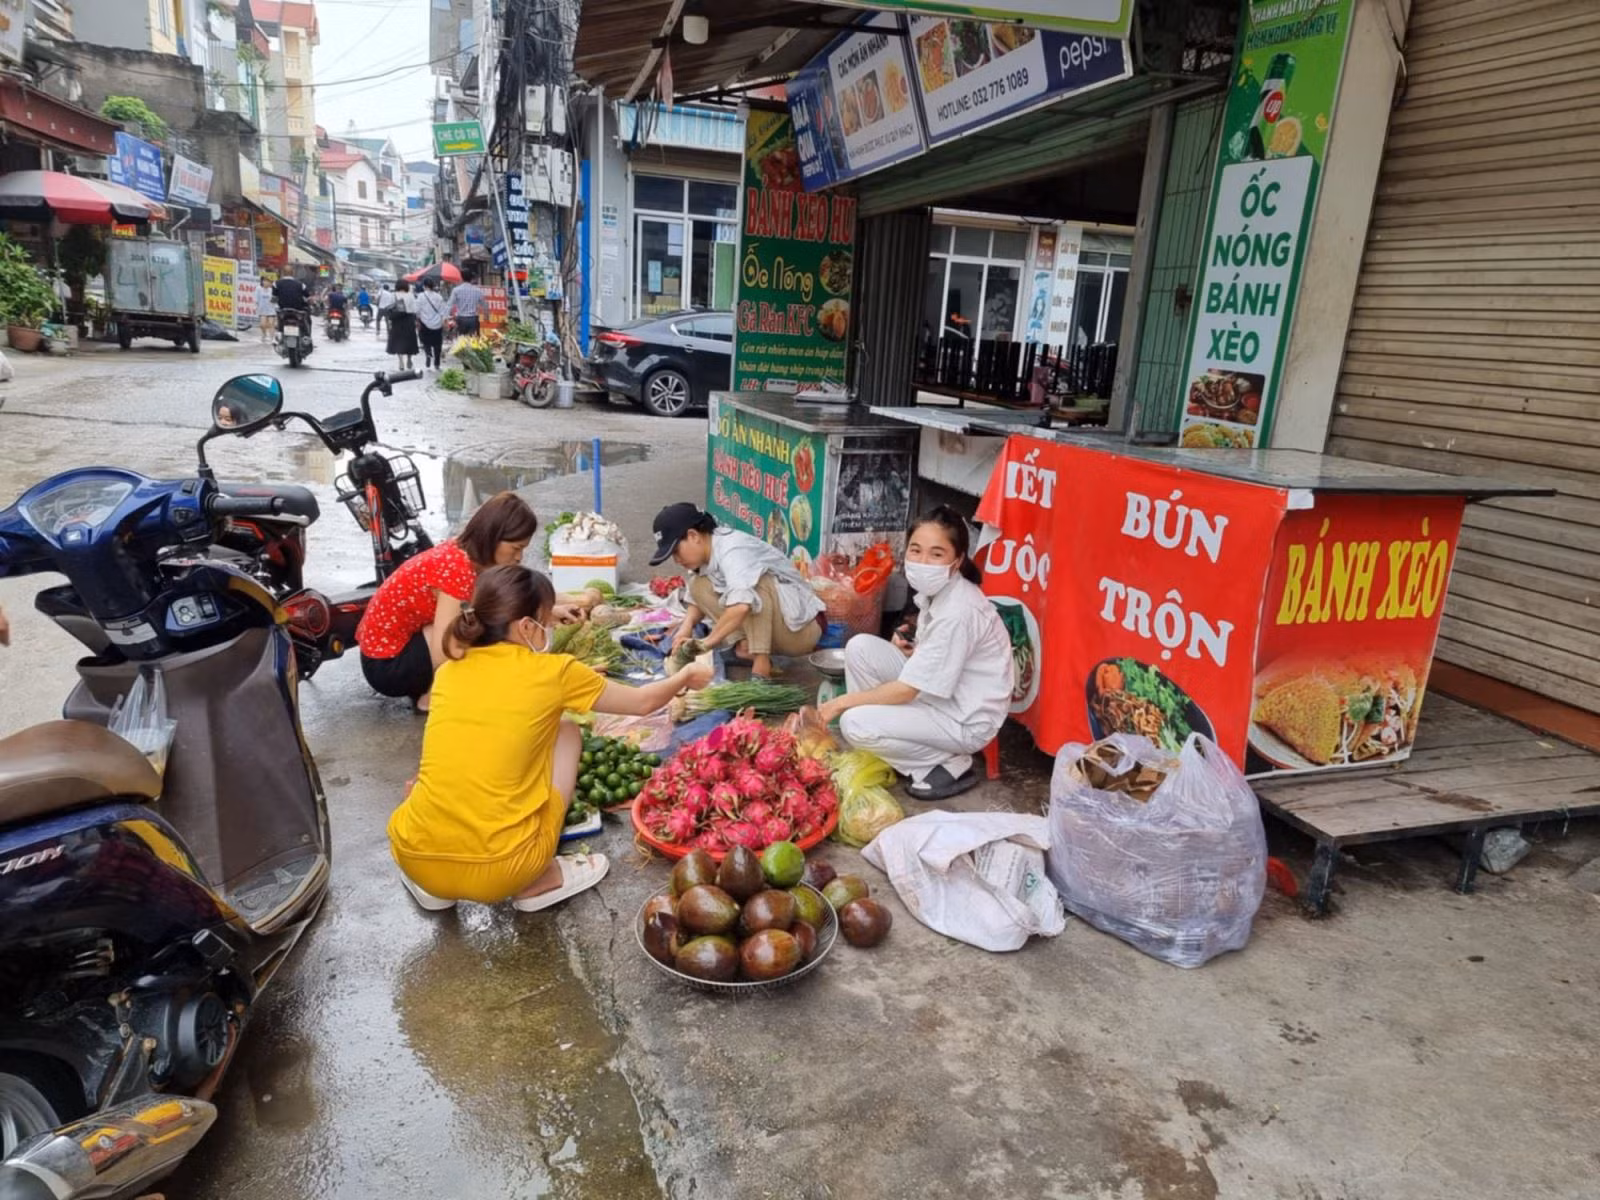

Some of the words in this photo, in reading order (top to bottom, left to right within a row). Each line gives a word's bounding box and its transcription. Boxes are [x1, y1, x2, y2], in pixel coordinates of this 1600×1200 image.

[1059, 36, 1107, 79] pepsi
[937, 95, 972, 122] HOTLINE:
[972, 86, 989, 107] 032
[989, 77, 1005, 100] 776
[1006, 67, 1029, 92] 1089
[745, 175, 793, 238] BÁNH
[1240, 166, 1281, 218] ỐC
[742, 242, 769, 288] Ốc
[1211, 223, 1292, 267] NÓNG
[1205, 271, 1281, 316] BÁNH
[785, 303, 815, 337] KFC
[1206, 321, 1260, 364] XÈO
[748, 427, 790, 465] NHANH
[763, 470, 791, 509] HUẾ
[1004, 447, 1057, 509] IẾT
[1120, 489, 1229, 563] BÚN
[1276, 517, 1380, 625] BÁNH
[1375, 516, 1449, 620] XÈO
[1099, 576, 1235, 667] TRỘN
